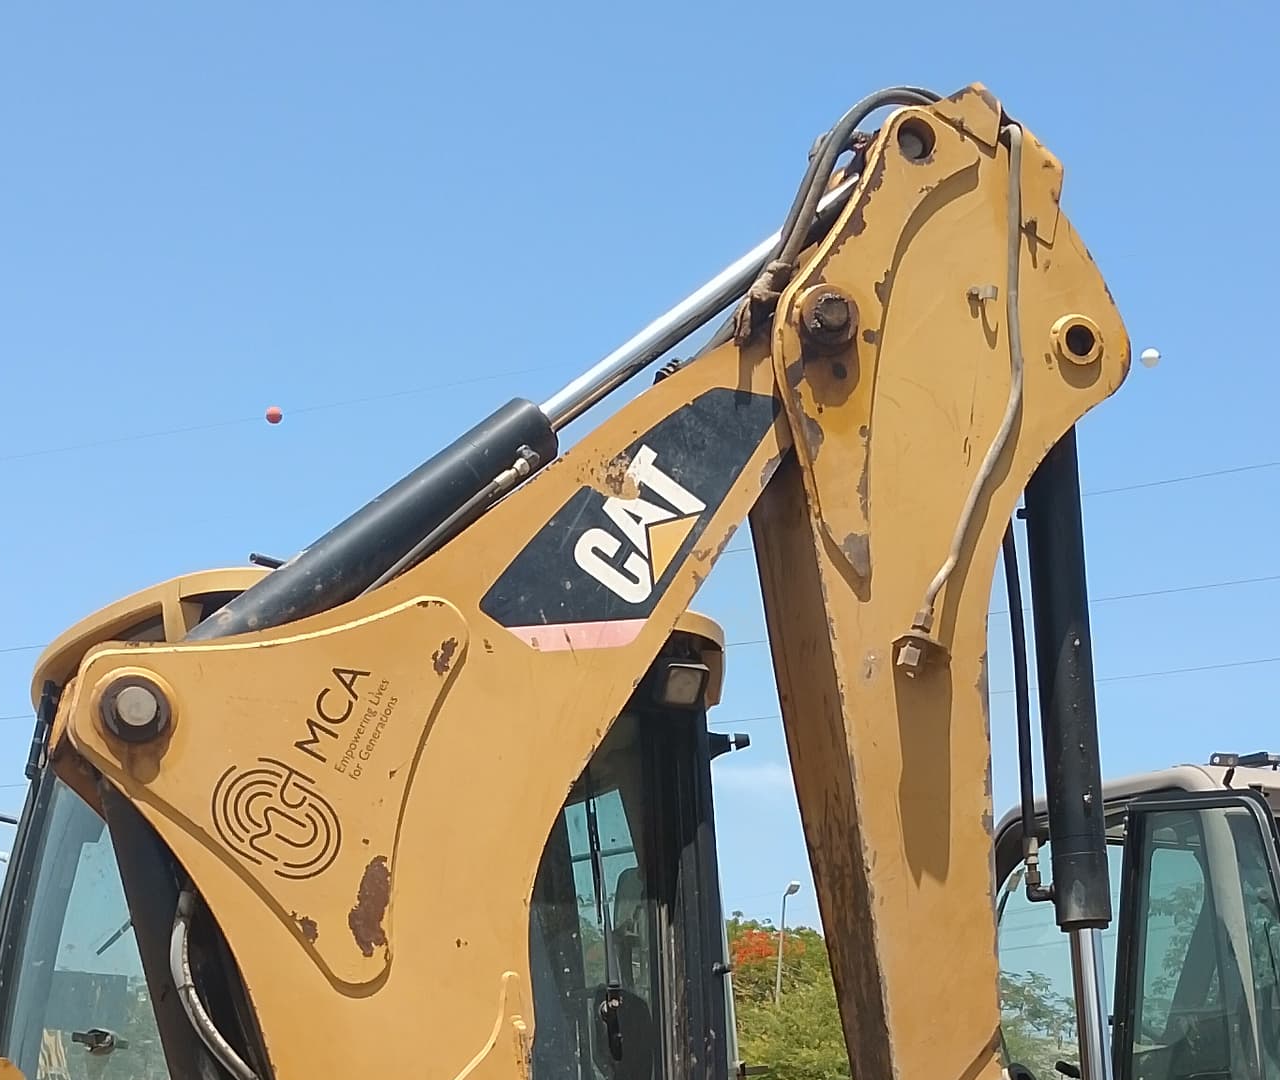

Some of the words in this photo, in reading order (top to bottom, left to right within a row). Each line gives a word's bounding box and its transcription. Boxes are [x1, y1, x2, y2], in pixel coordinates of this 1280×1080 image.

[574, 443, 707, 603] CAT
[294, 667, 371, 763] MCA
[334, 706, 378, 773] Empowering
[368, 678, 390, 706] Lives
[349, 762, 363, 780] for
[358, 696, 398, 760] Generations
